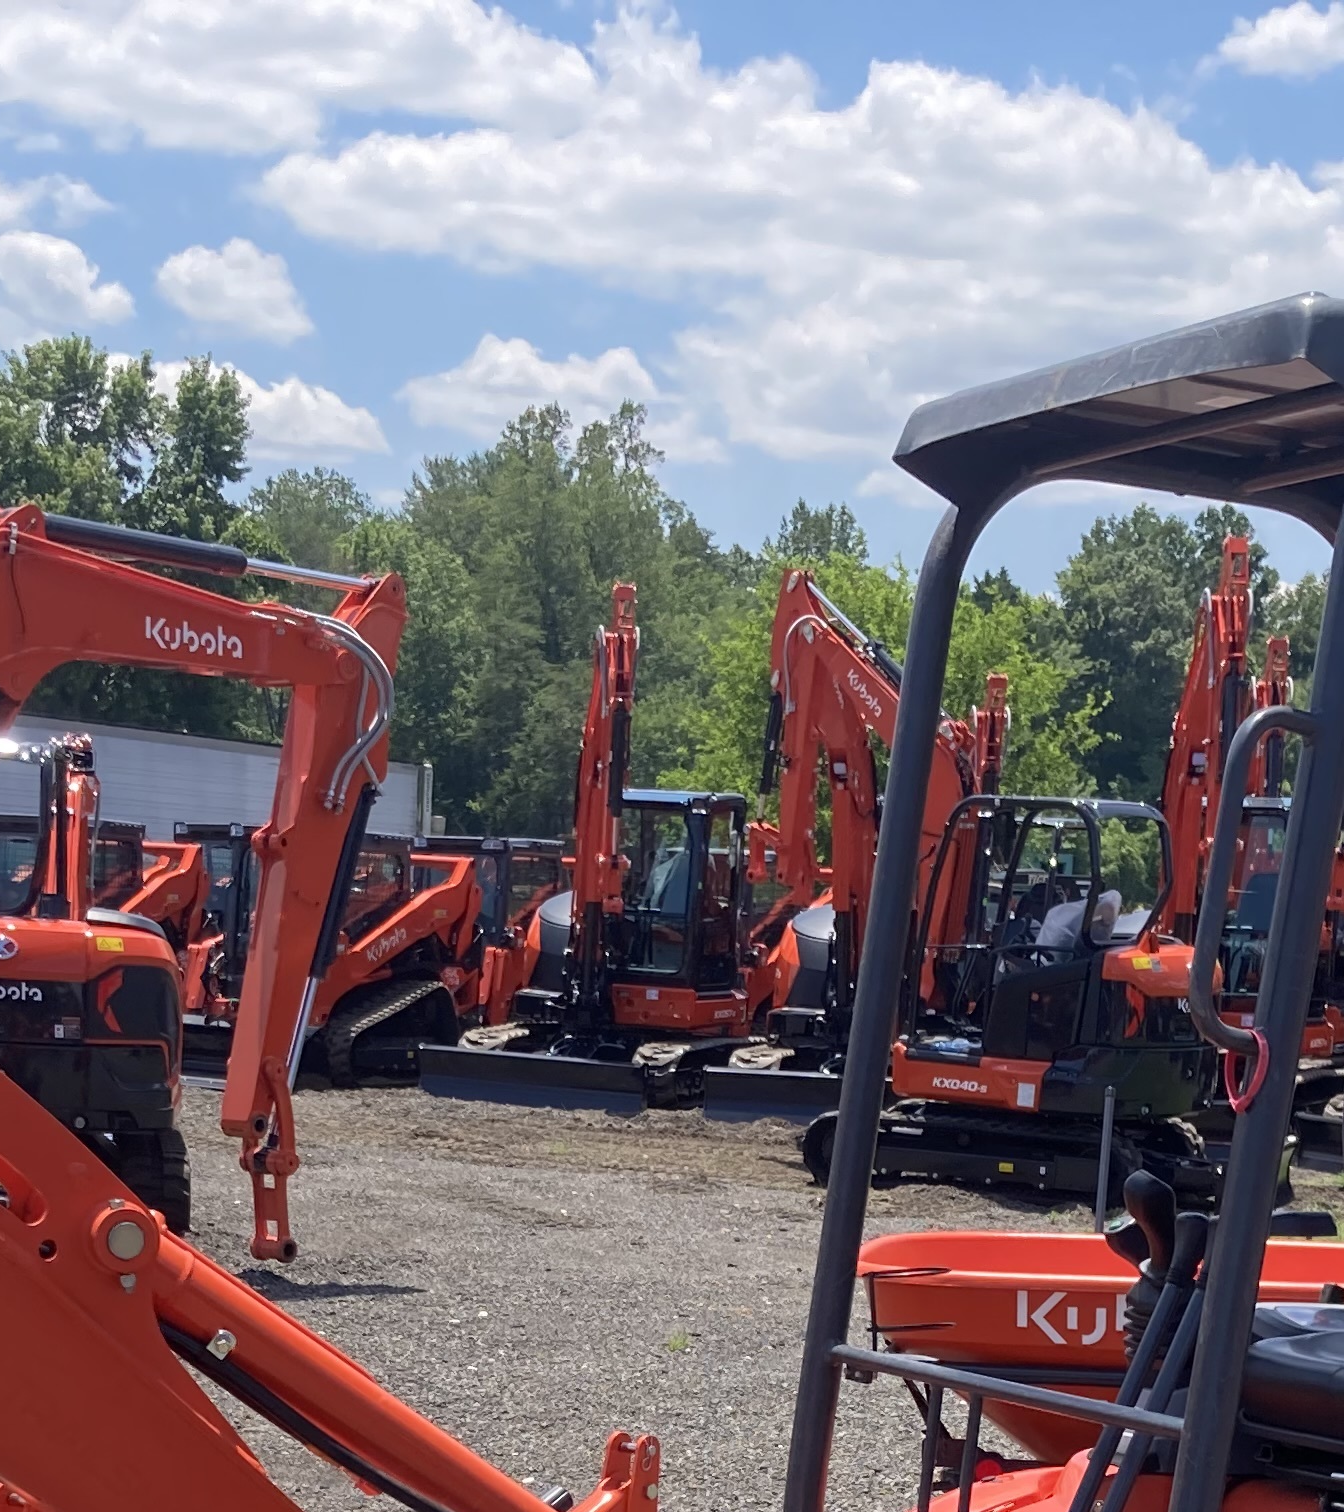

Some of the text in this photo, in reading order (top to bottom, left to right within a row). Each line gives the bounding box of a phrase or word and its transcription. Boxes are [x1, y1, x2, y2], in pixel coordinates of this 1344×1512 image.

[144, 615, 243, 659] Kubota
[847, 668, 882, 718] Kubota
[366, 927, 408, 962] Kubota
